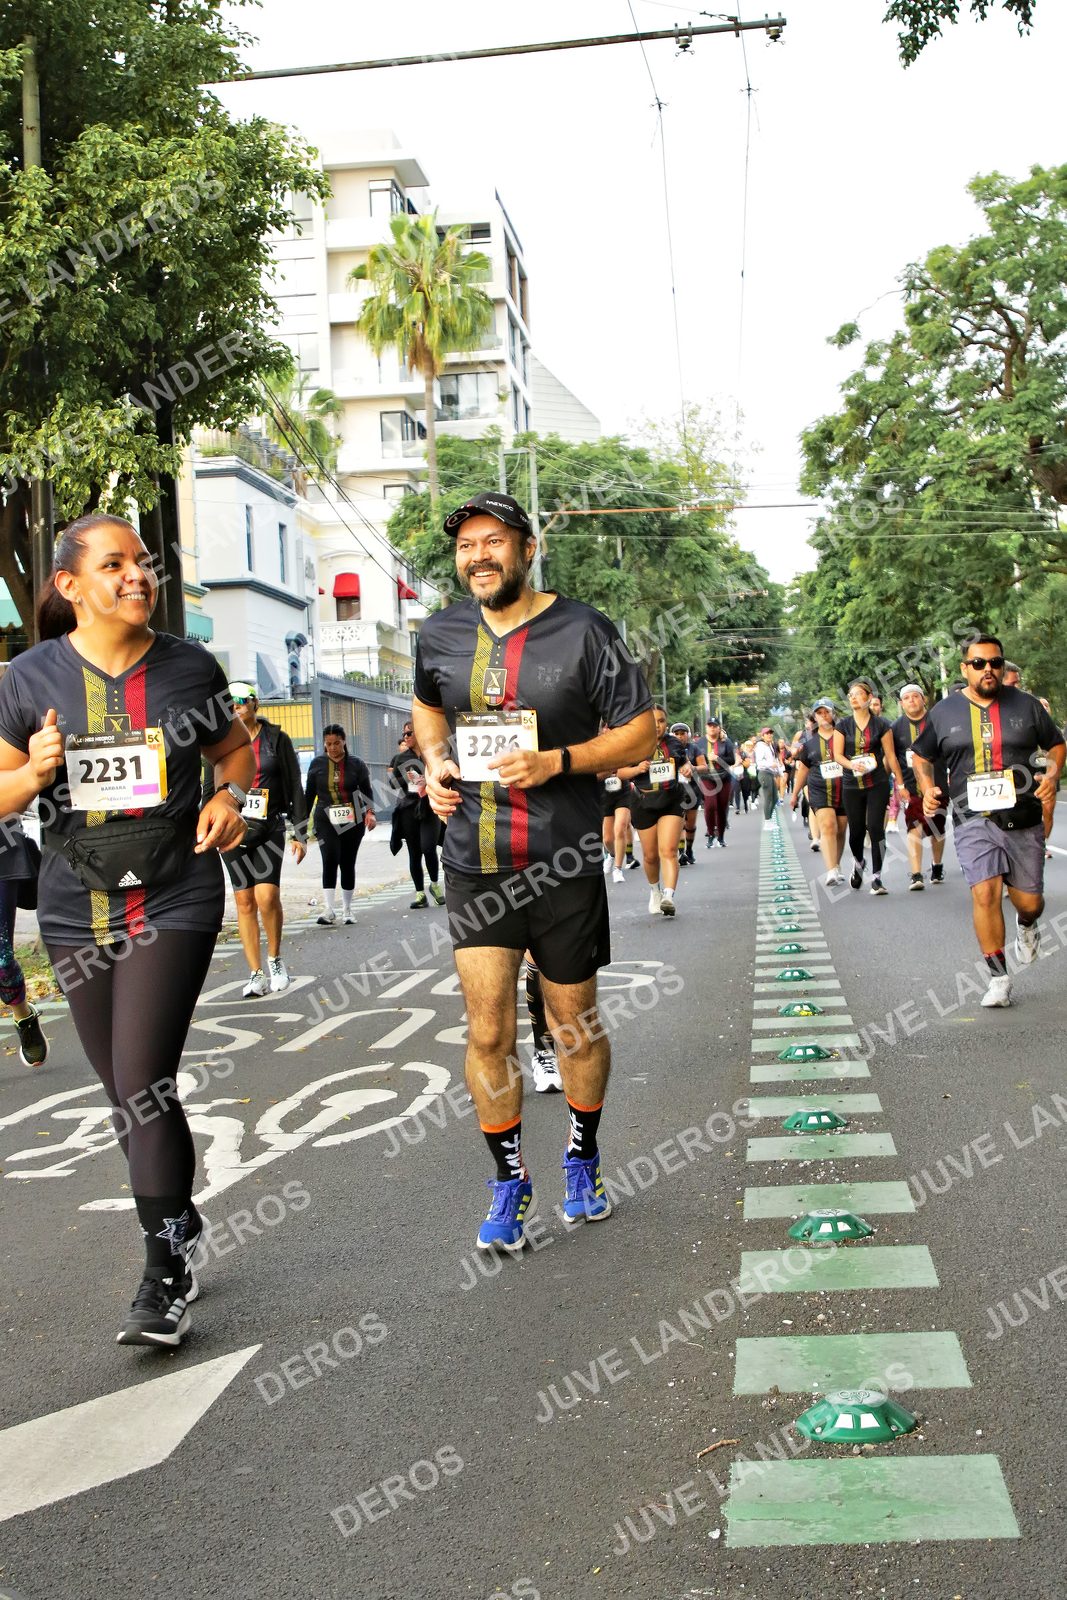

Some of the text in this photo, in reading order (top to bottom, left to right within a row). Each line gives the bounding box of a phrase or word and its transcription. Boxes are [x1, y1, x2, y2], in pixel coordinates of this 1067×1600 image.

[467, 735, 520, 757] 3286
[79, 755, 143, 784] 2231
[652, 765, 670, 774] 4491
[973, 783, 1004, 798] 7257
[333, 809, 351, 817] 1529
[118, 879, 142, 887] adidas
